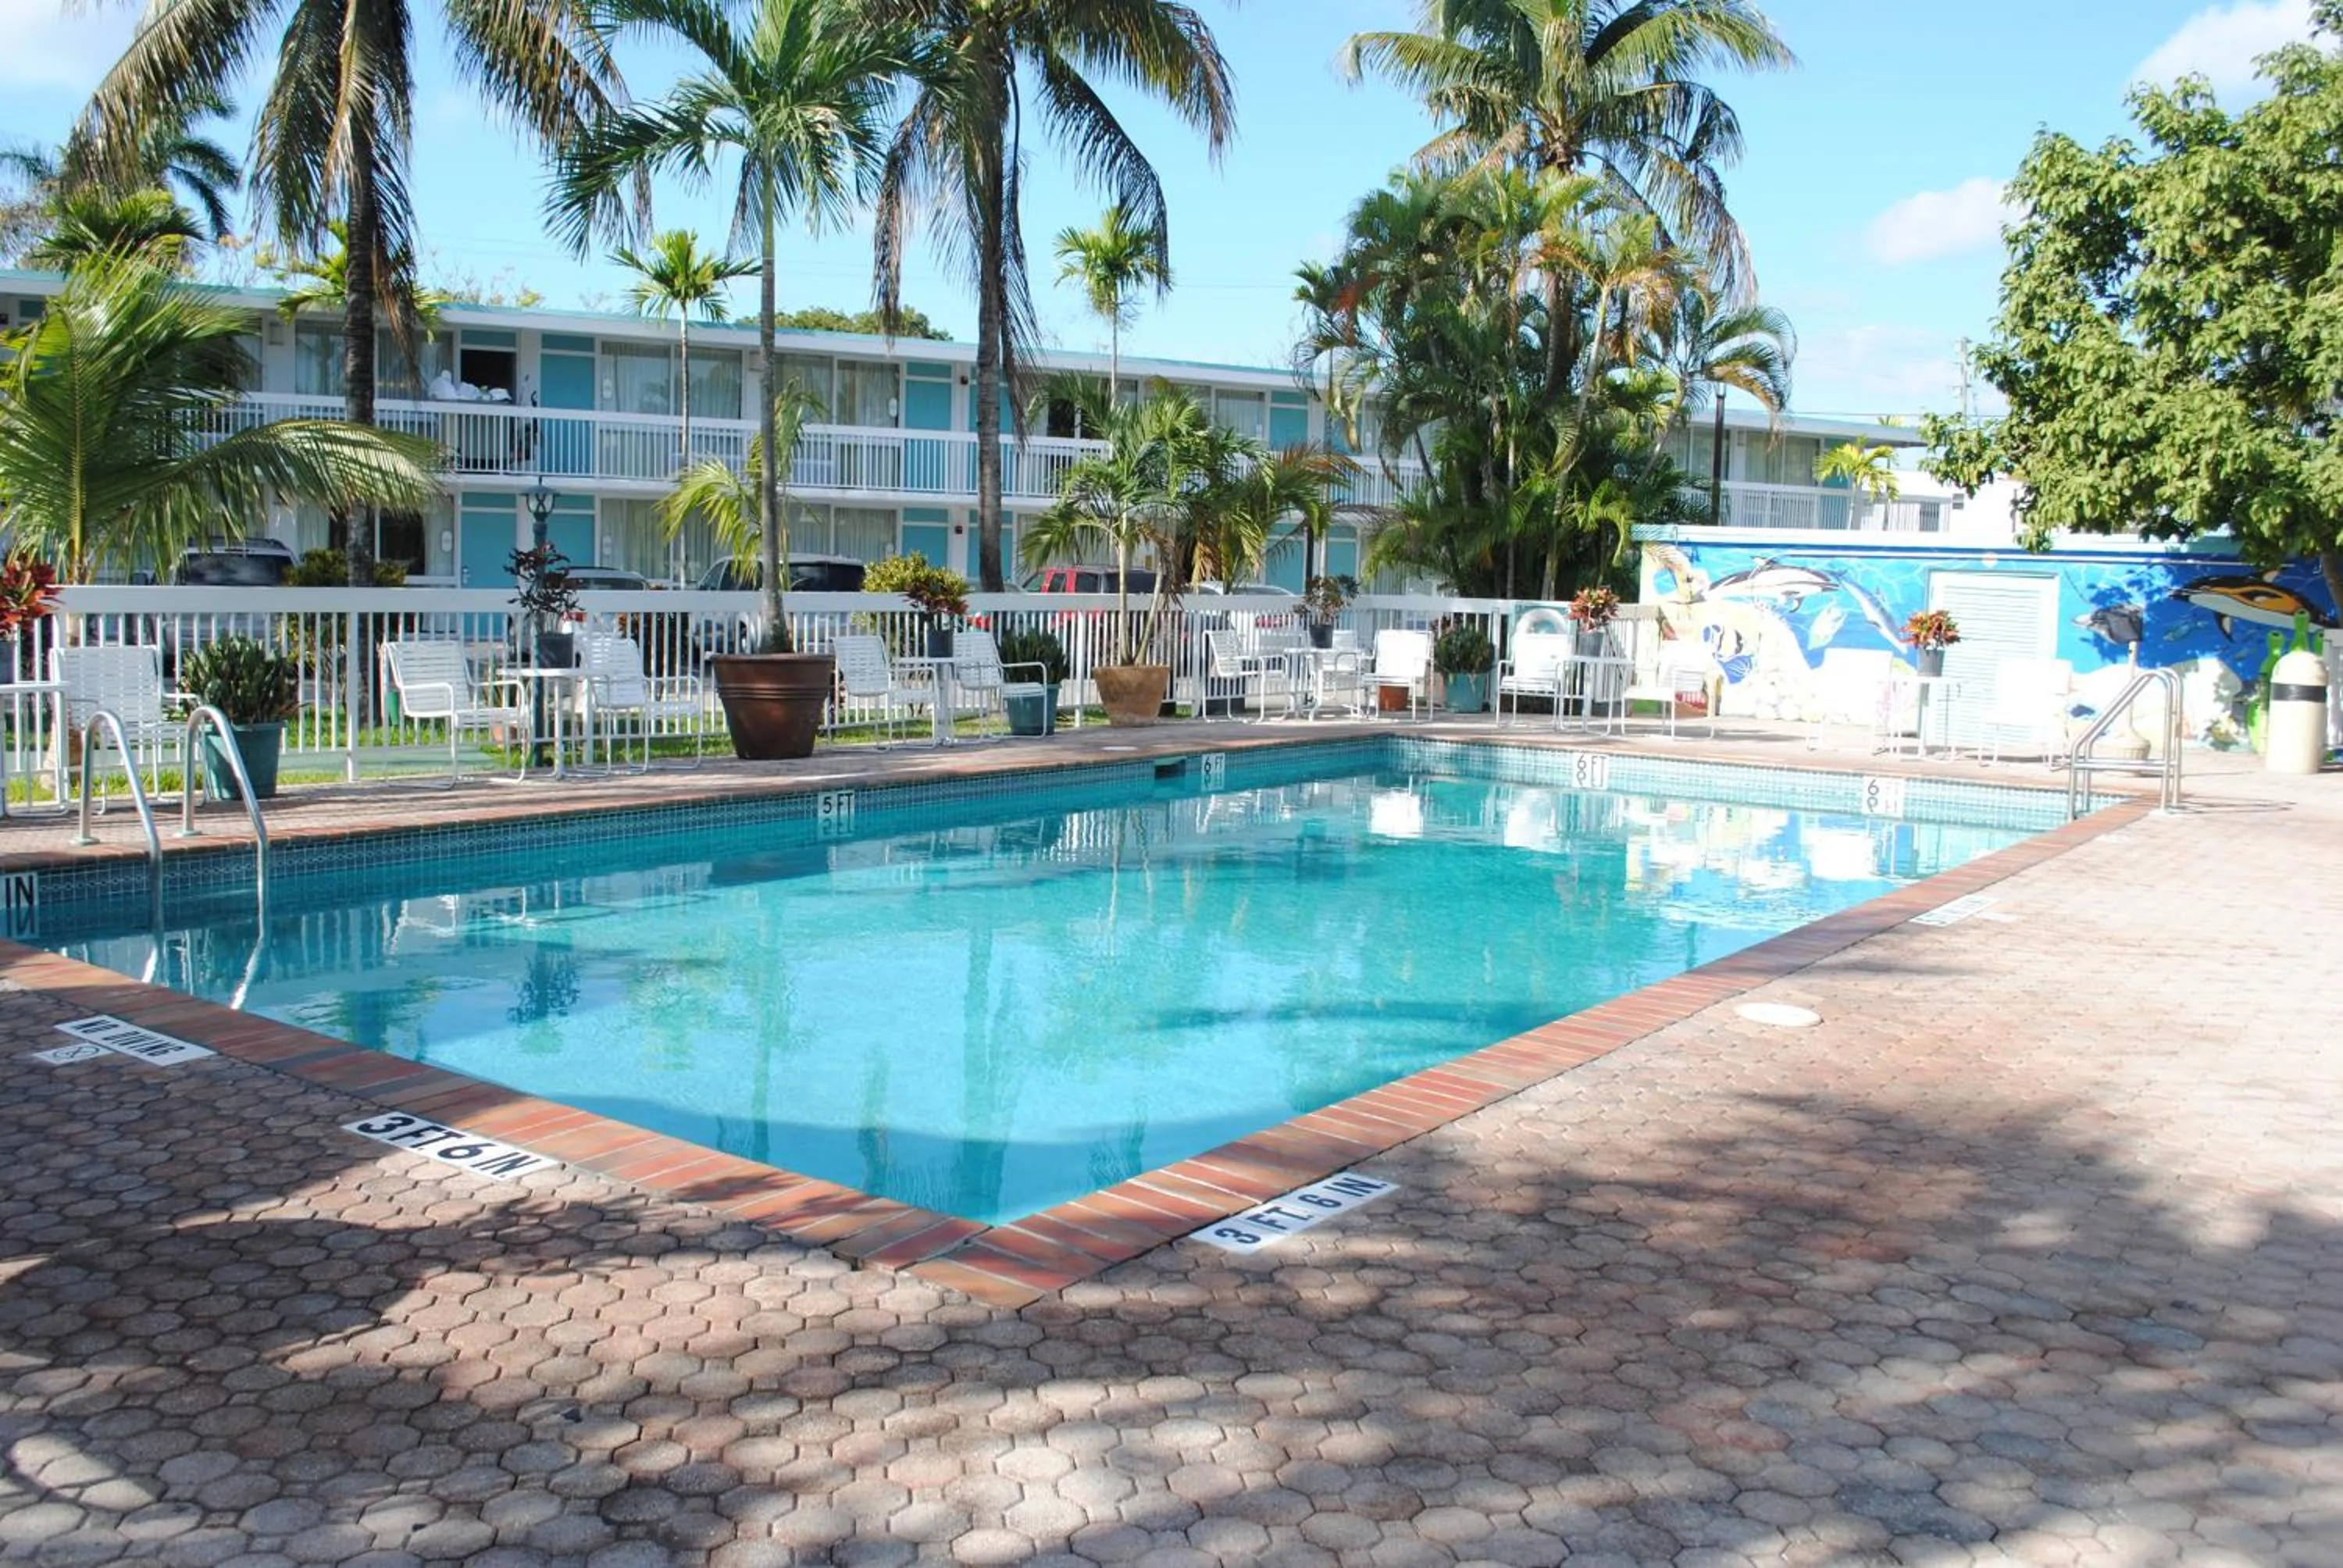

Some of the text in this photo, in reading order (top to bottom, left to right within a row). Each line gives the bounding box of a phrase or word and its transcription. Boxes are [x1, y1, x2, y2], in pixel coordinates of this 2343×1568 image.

[1204, 756, 1224, 773] 6 FT
[1577, 754, 1607, 772] 6 FT
[1867, 779, 1879, 796] 6
[822, 793, 853, 814] 5 FT
[73, 1019, 187, 1057] NO DIVING
[356, 1116, 415, 1134] 3
[437, 1142, 497, 1160] 6
[1214, 1228, 1261, 1244] 3
[1297, 1193, 1343, 1209] 6
